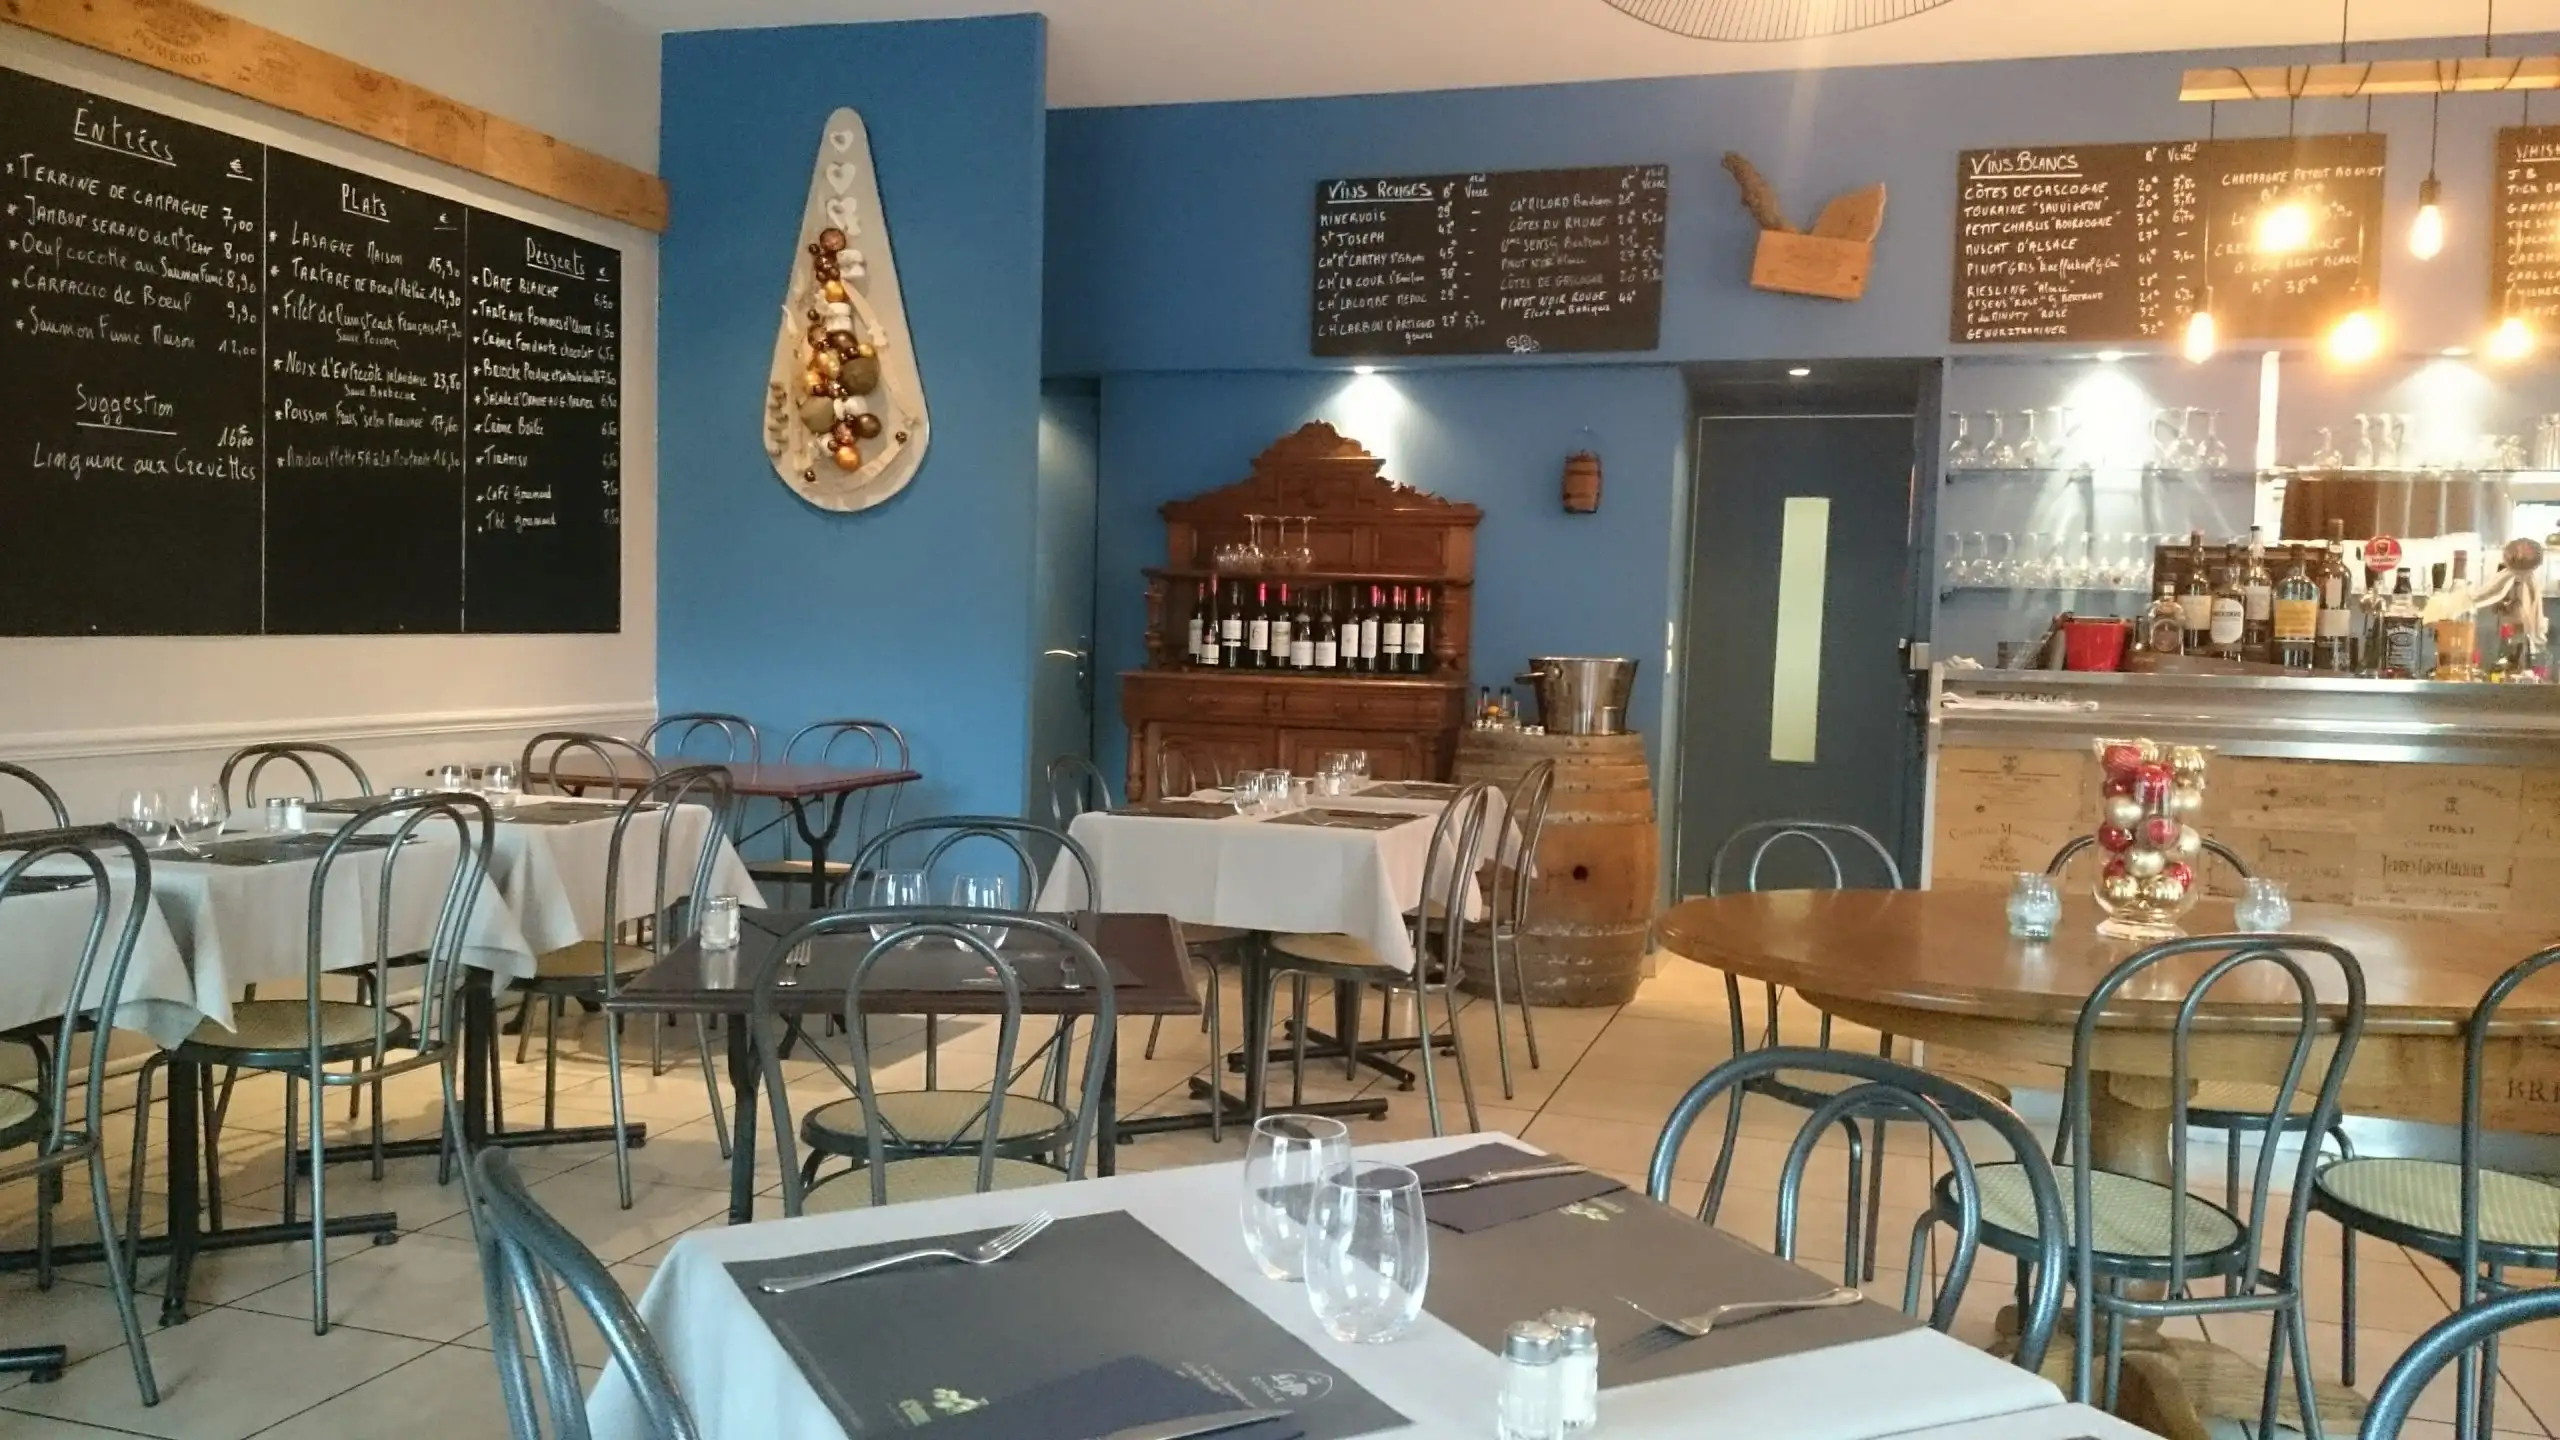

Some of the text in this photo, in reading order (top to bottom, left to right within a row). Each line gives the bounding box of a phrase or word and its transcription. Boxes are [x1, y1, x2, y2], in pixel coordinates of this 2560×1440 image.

[20, 153, 254, 233] TERRINE DE CAMPAGNE 7,00
[2033, 182, 2108, 198] GASCOGNE
[24, 195, 84, 229] JAMBON
[91, 216, 149, 243] SERANO
[224, 242, 255, 265] 8,00
[1320, 208, 1386, 226] MINERVOIS
[291, 220, 354, 258] LASAGNE
[428, 256, 461, 280] 15,90
[1337, 231, 1385, 246] JOSEPH
[227, 269, 257, 293] 8,90
[1966, 285, 2028, 298] RIESLING
[114, 284, 134, 304] de
[227, 300, 257, 324] 9,90
[30, 305, 95, 339] Saumon
[218, 339, 257, 356] 12,00
[76, 383, 173, 425] Suggestion
[284, 398, 328, 422] Poisson
[33, 442, 125, 480] Linguine
[134, 459, 169, 474] aux
